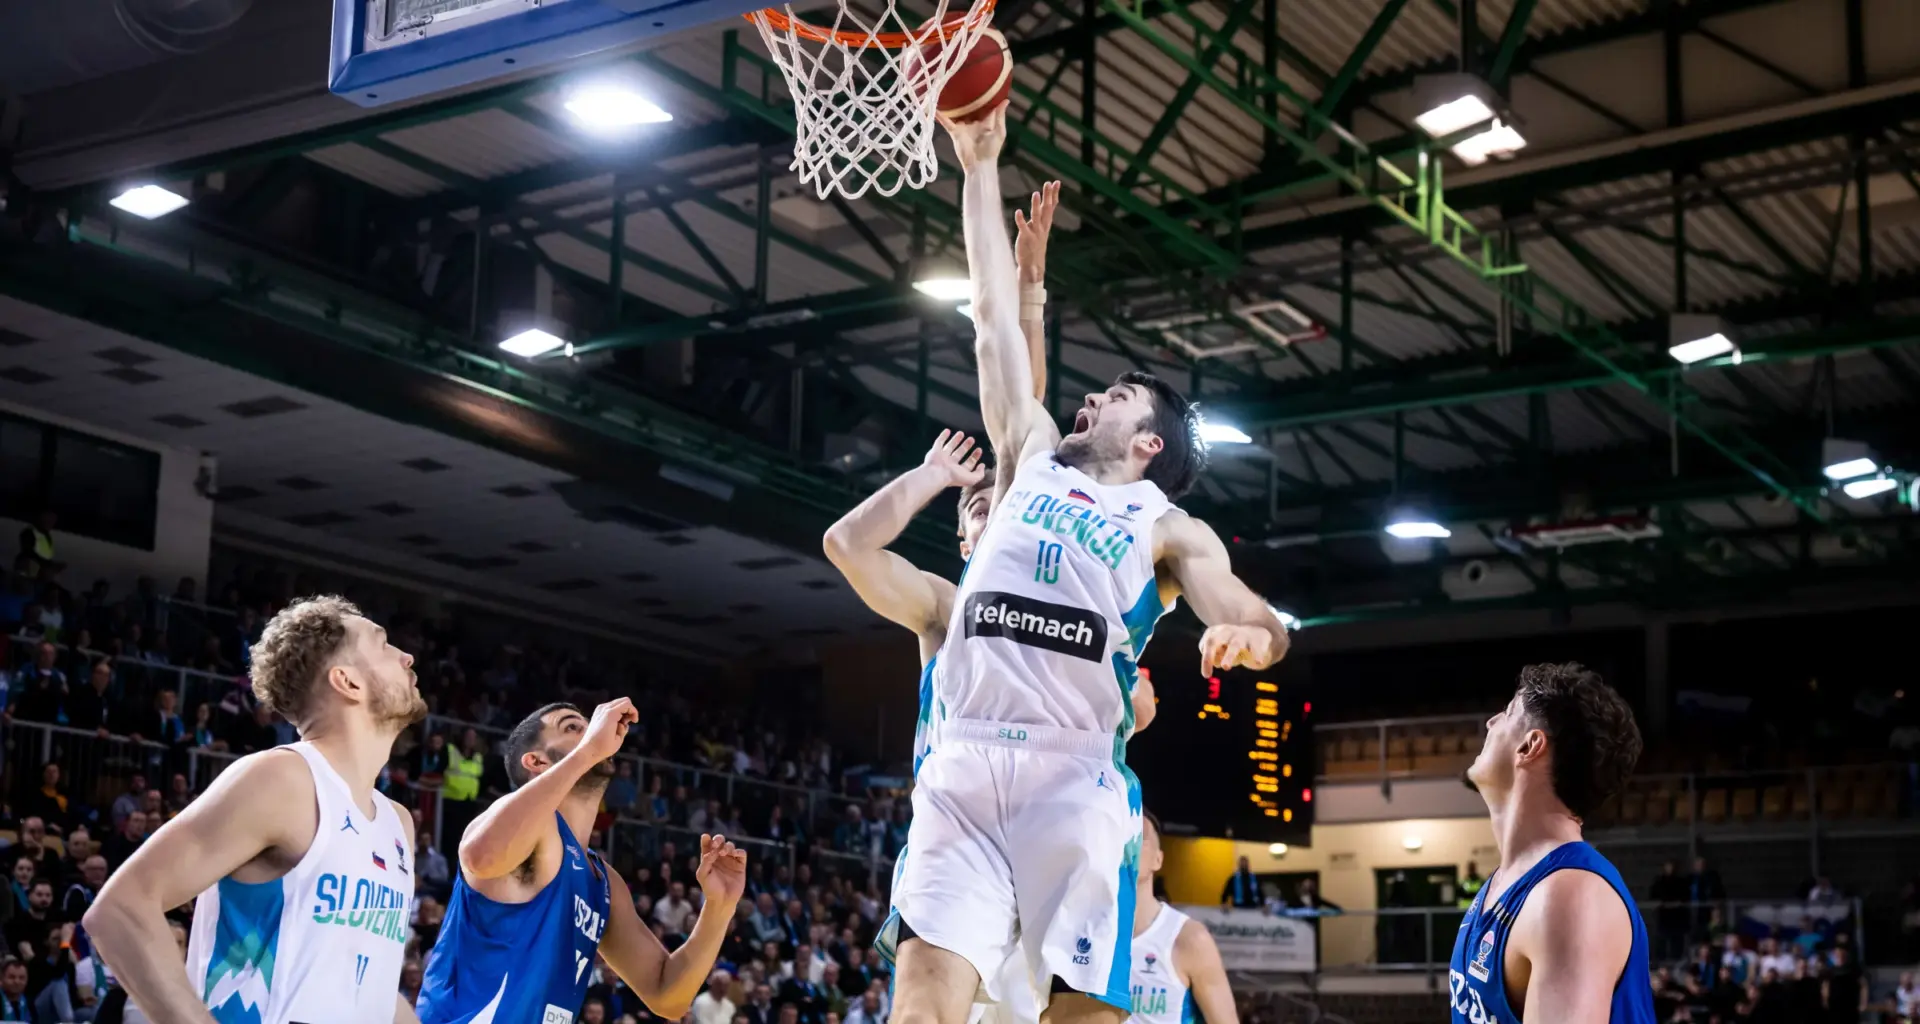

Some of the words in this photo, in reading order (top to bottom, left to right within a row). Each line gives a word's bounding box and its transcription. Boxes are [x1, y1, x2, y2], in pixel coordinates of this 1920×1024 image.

[1034, 540, 1063, 585] 10
[974, 602, 1094, 647] telemach
[1072, 954, 1090, 966] KZS
